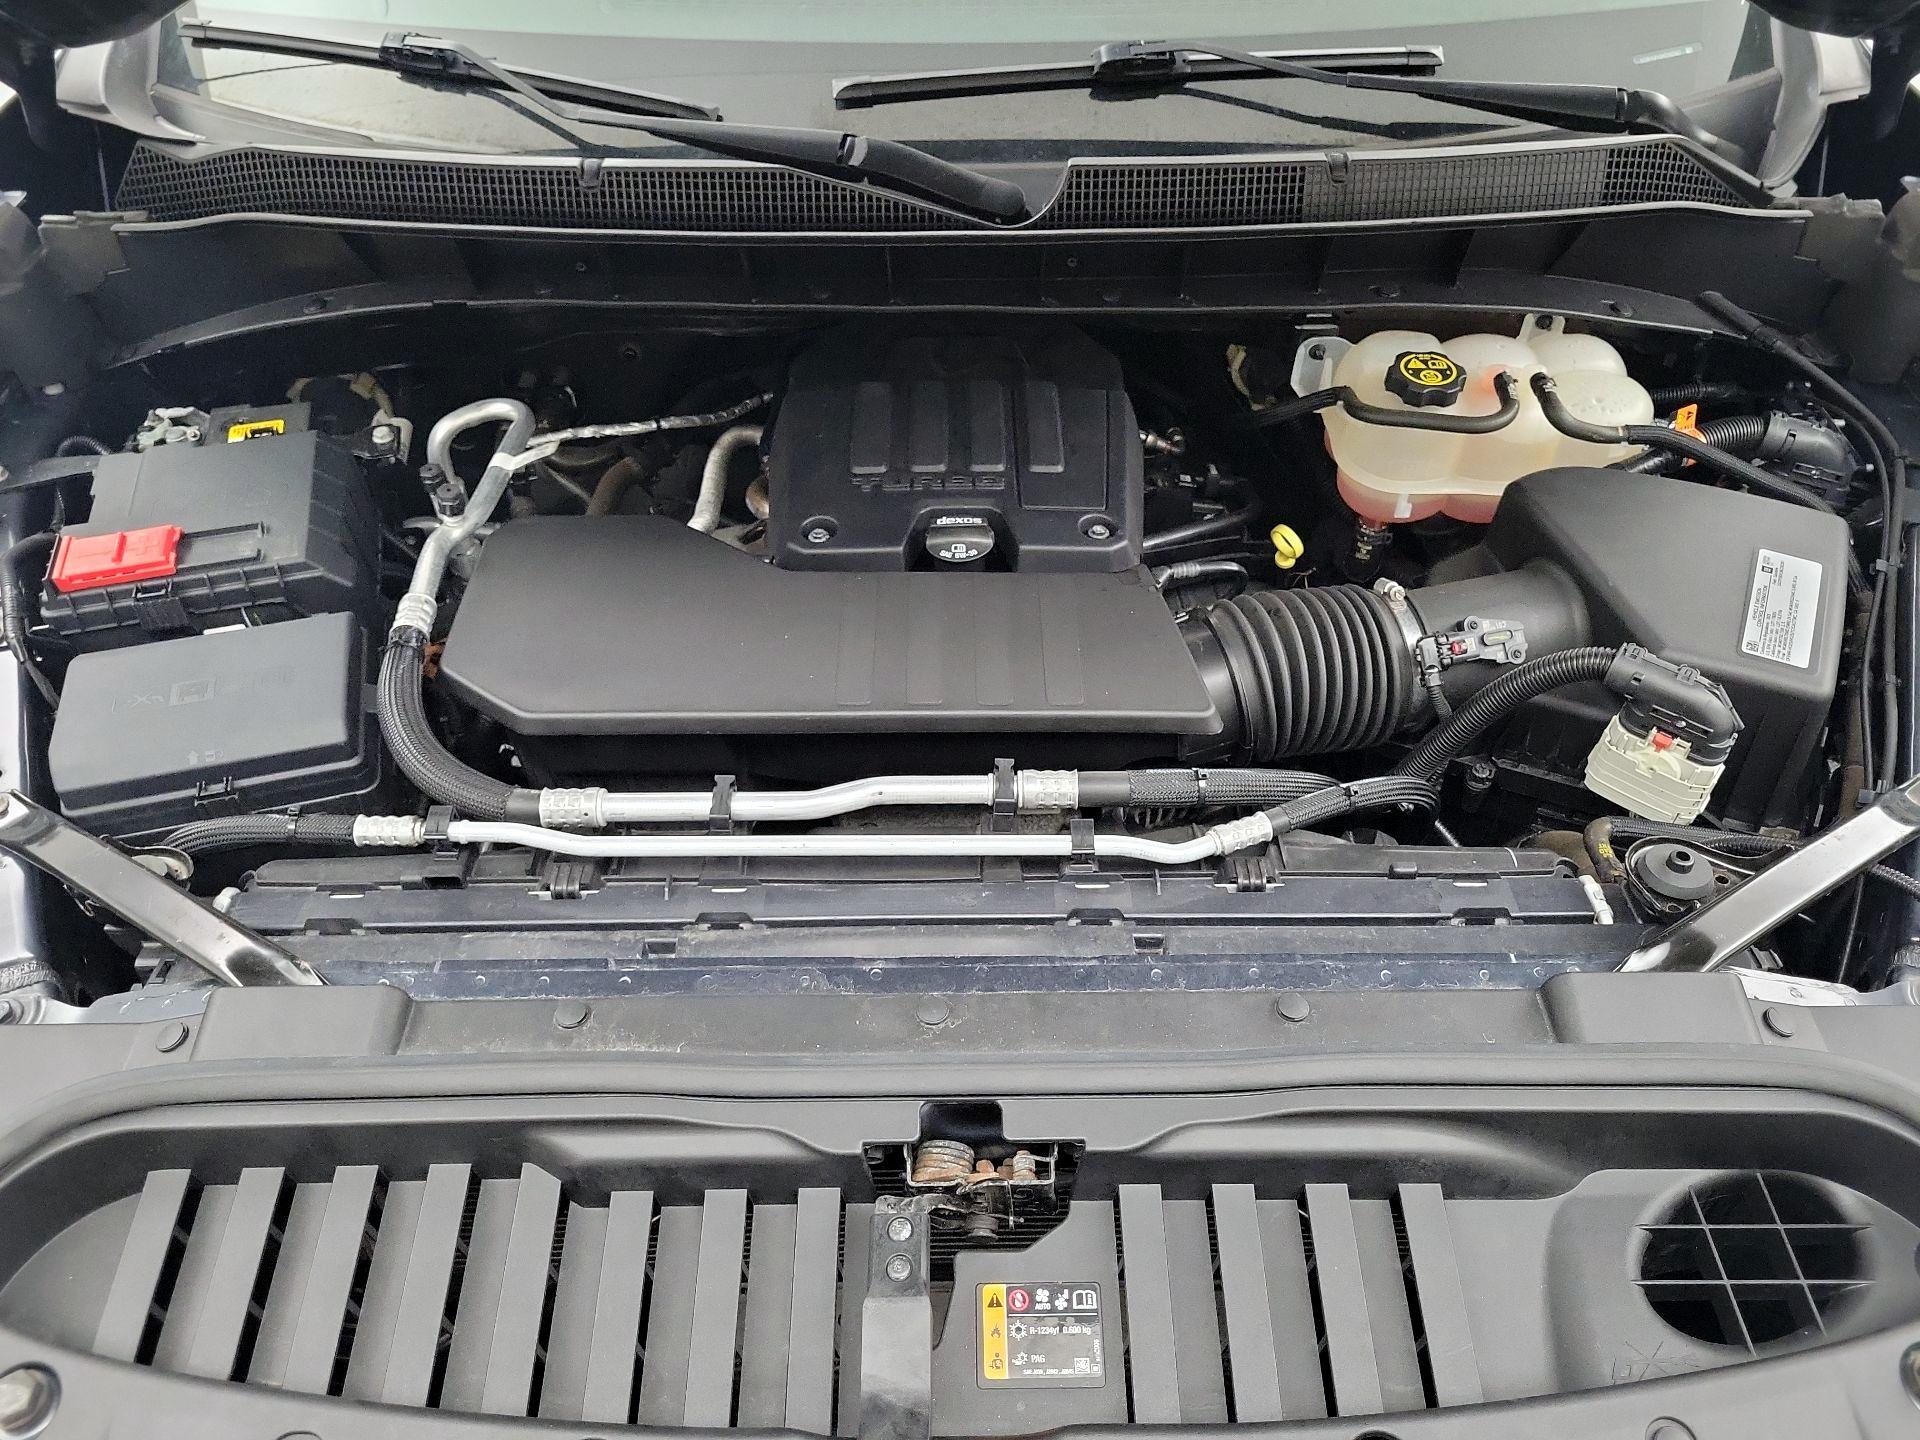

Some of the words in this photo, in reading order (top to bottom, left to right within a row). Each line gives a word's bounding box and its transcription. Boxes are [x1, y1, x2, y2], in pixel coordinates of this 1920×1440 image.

[936, 516, 983, 525] dexos
[1082, 1326, 1092, 1336] kg
[1030, 1354, 1046, 1363] PAG
